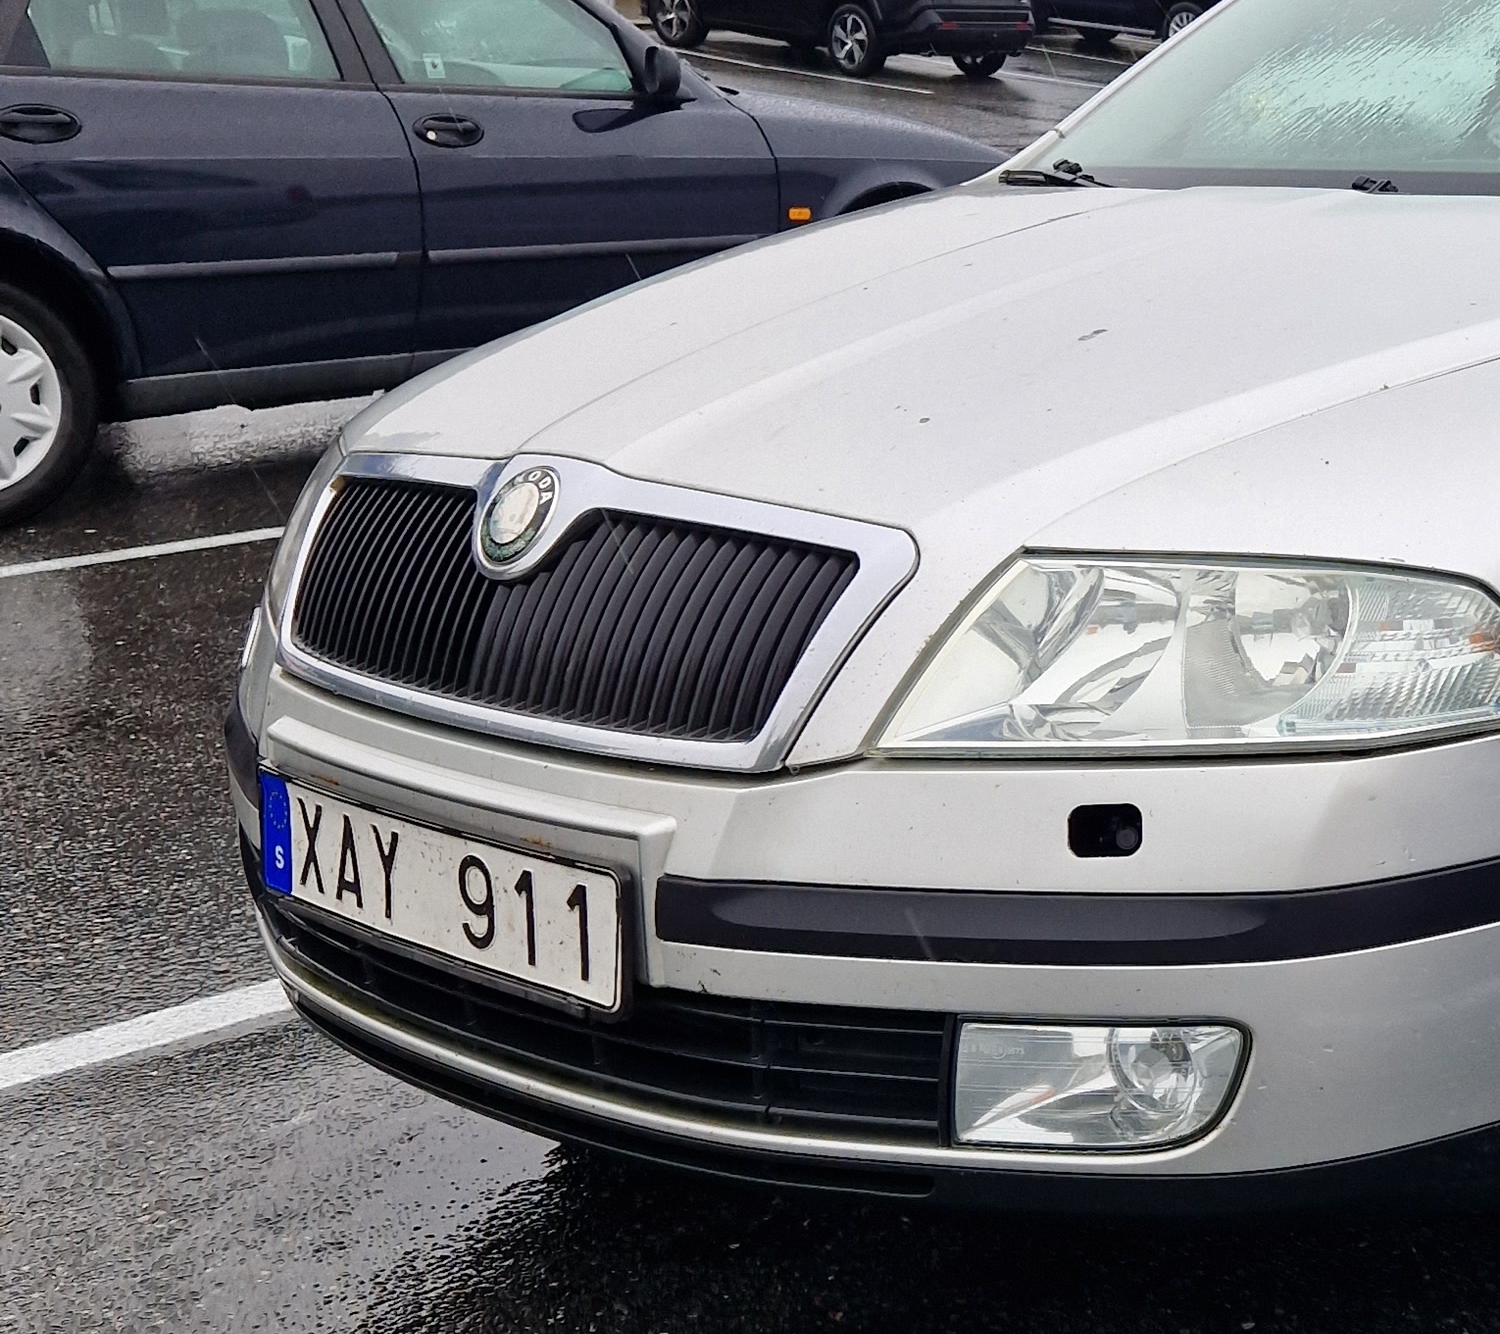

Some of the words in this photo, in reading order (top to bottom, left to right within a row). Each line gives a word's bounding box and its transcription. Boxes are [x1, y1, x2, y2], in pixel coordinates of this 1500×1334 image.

[275, 845, 285, 869] S
[297, 798, 398, 919] XAY
[458, 854, 589, 981] 911
